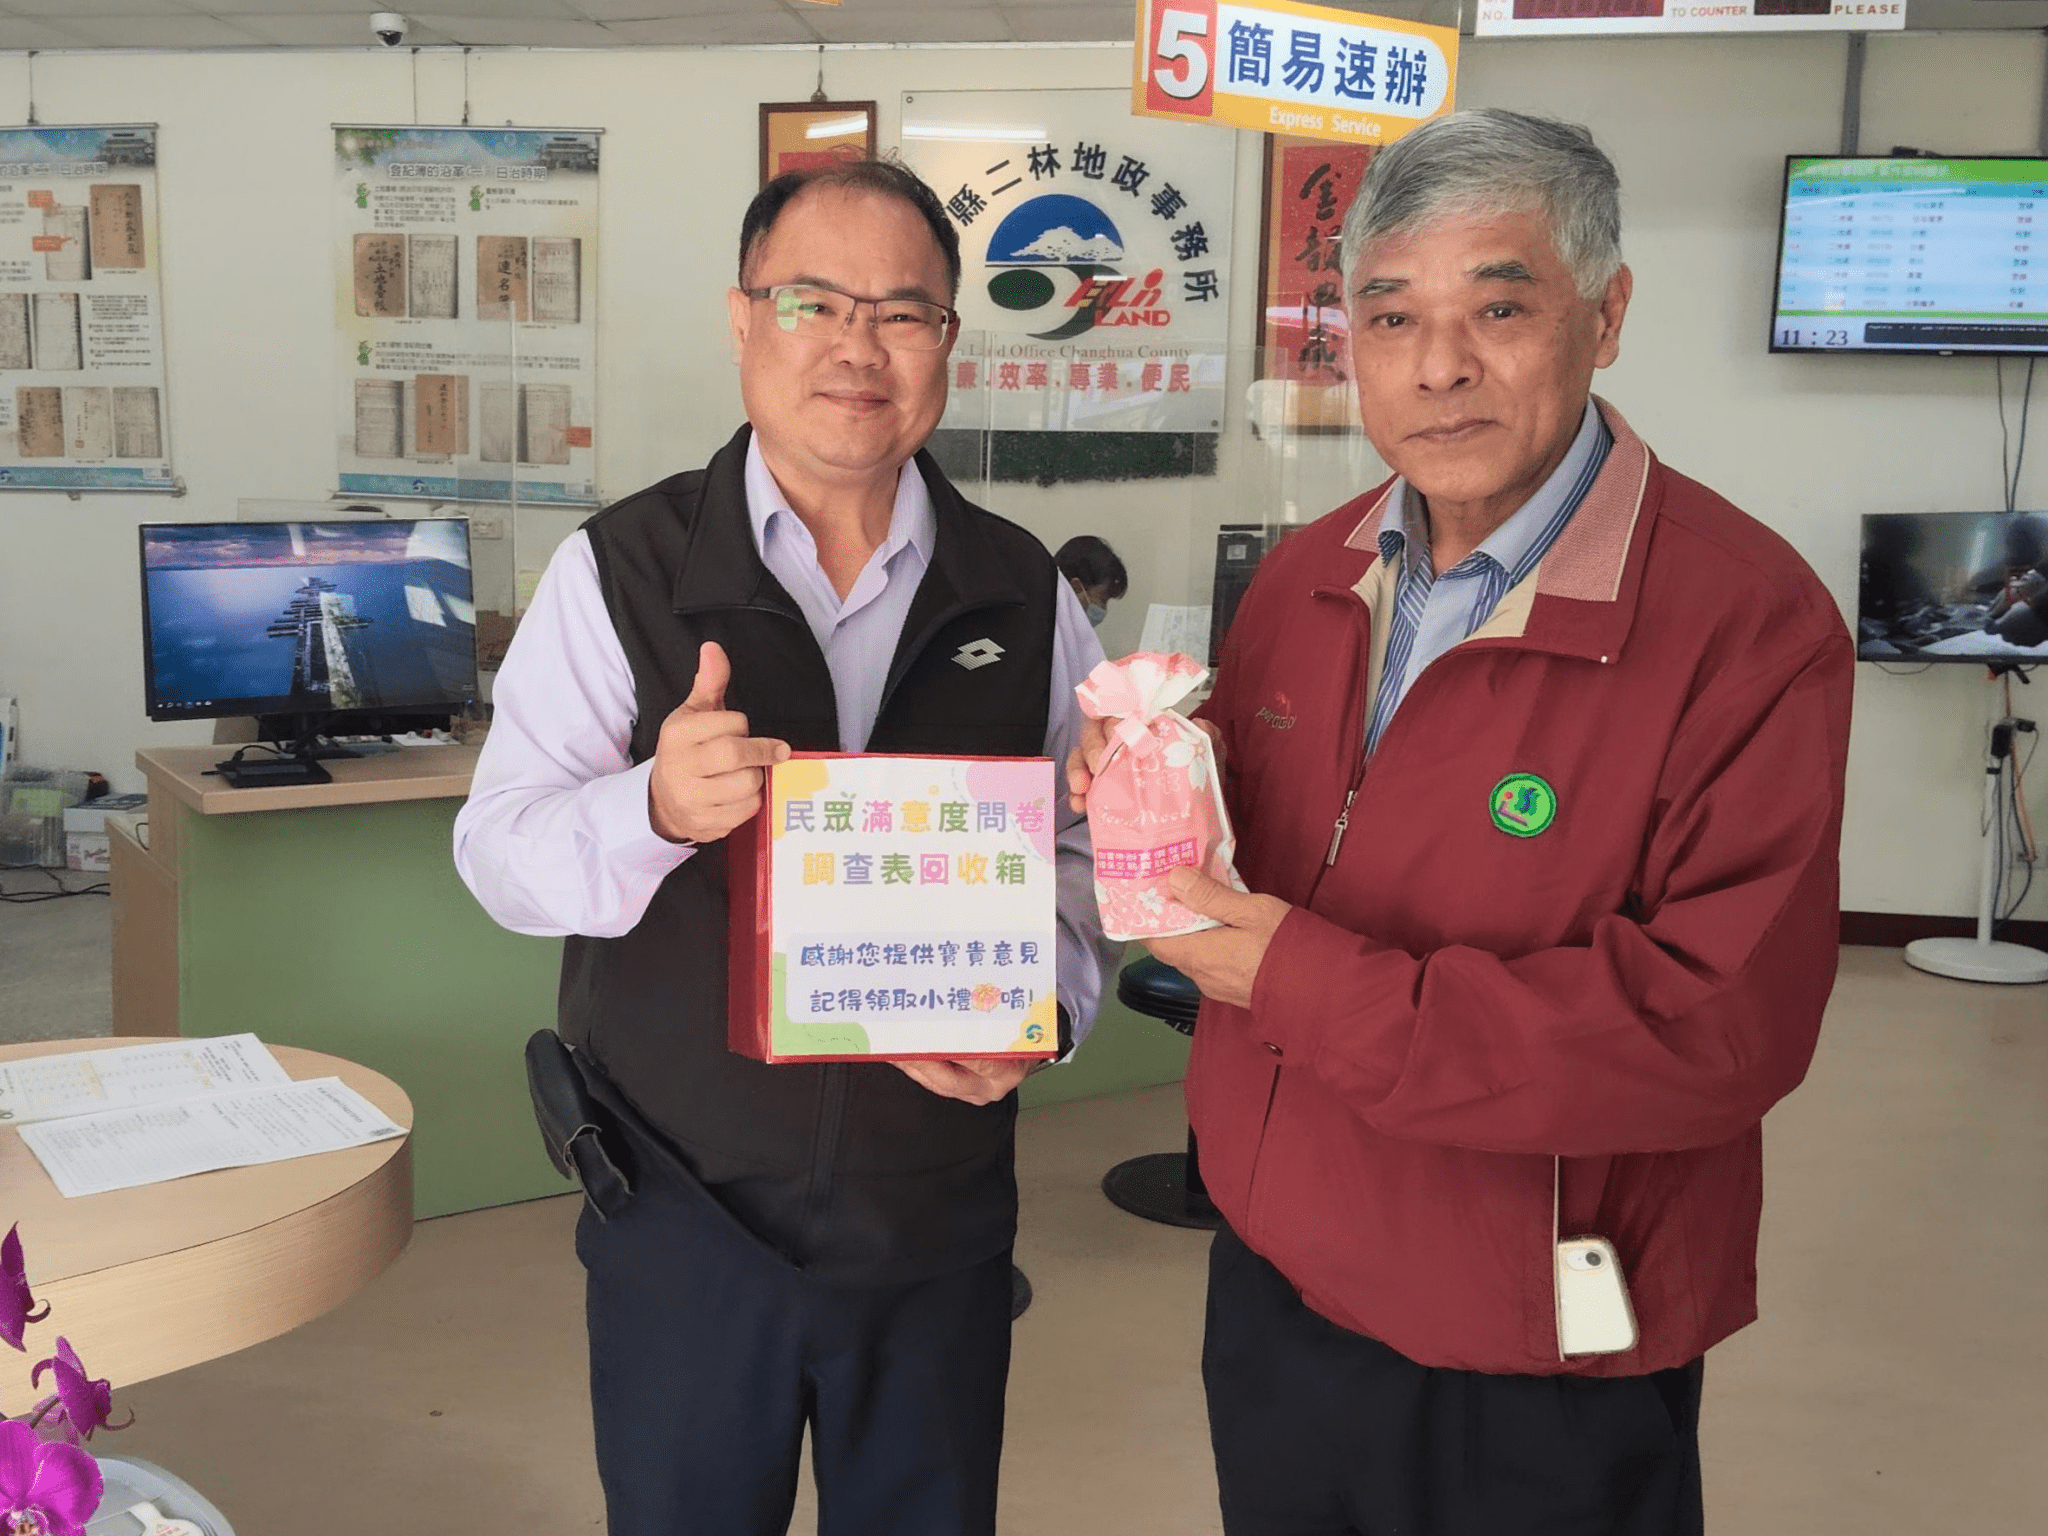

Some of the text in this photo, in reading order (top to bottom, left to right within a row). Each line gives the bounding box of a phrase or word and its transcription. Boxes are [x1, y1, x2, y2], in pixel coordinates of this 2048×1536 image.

[1671, 7, 1686, 17] TO
[1690, 6, 1747, 17] COUNTER
[1834, 4, 1900, 15] PLEASE
[1153, 9, 1209, 99] 5
[1227, 19, 1428, 107] 簡易速辦
[1268, 106, 1382, 138] Express Service
[1090, 309, 1172, 327] LAND
[1009, 343, 1055, 359] Office
[1059, 343, 1134, 361] Changhua
[1137, 344, 1193, 361] County
[784, 798, 1046, 834] 民眾滿意度問卷
[801, 851, 1027, 886] 調查表回收箱
[800, 941, 1040, 967] 感謝您提供寶貴意見
